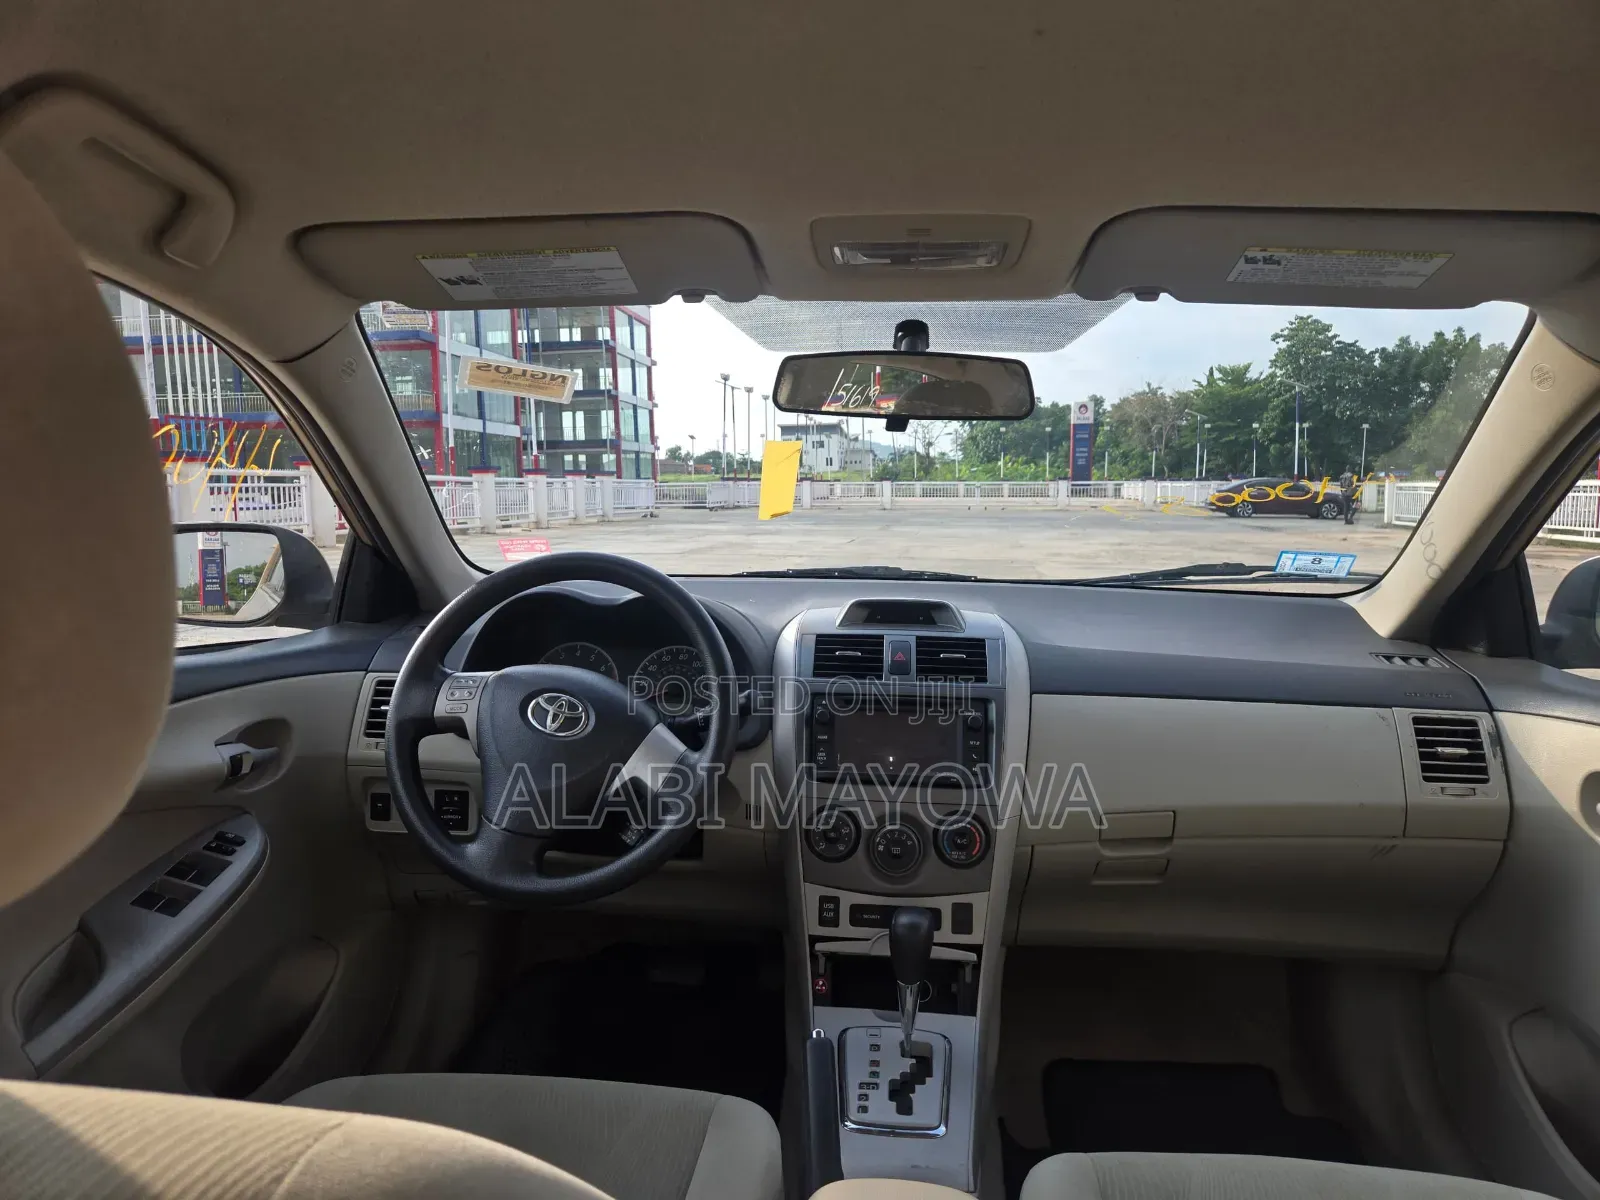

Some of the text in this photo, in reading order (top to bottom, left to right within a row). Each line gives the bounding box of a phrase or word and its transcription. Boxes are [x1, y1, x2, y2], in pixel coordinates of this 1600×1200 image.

[1310, 557, 1323, 565] 8
[661, 654, 671, 662] 60
[678, 653, 689, 661] 80
[648, 664, 658, 672] 40
